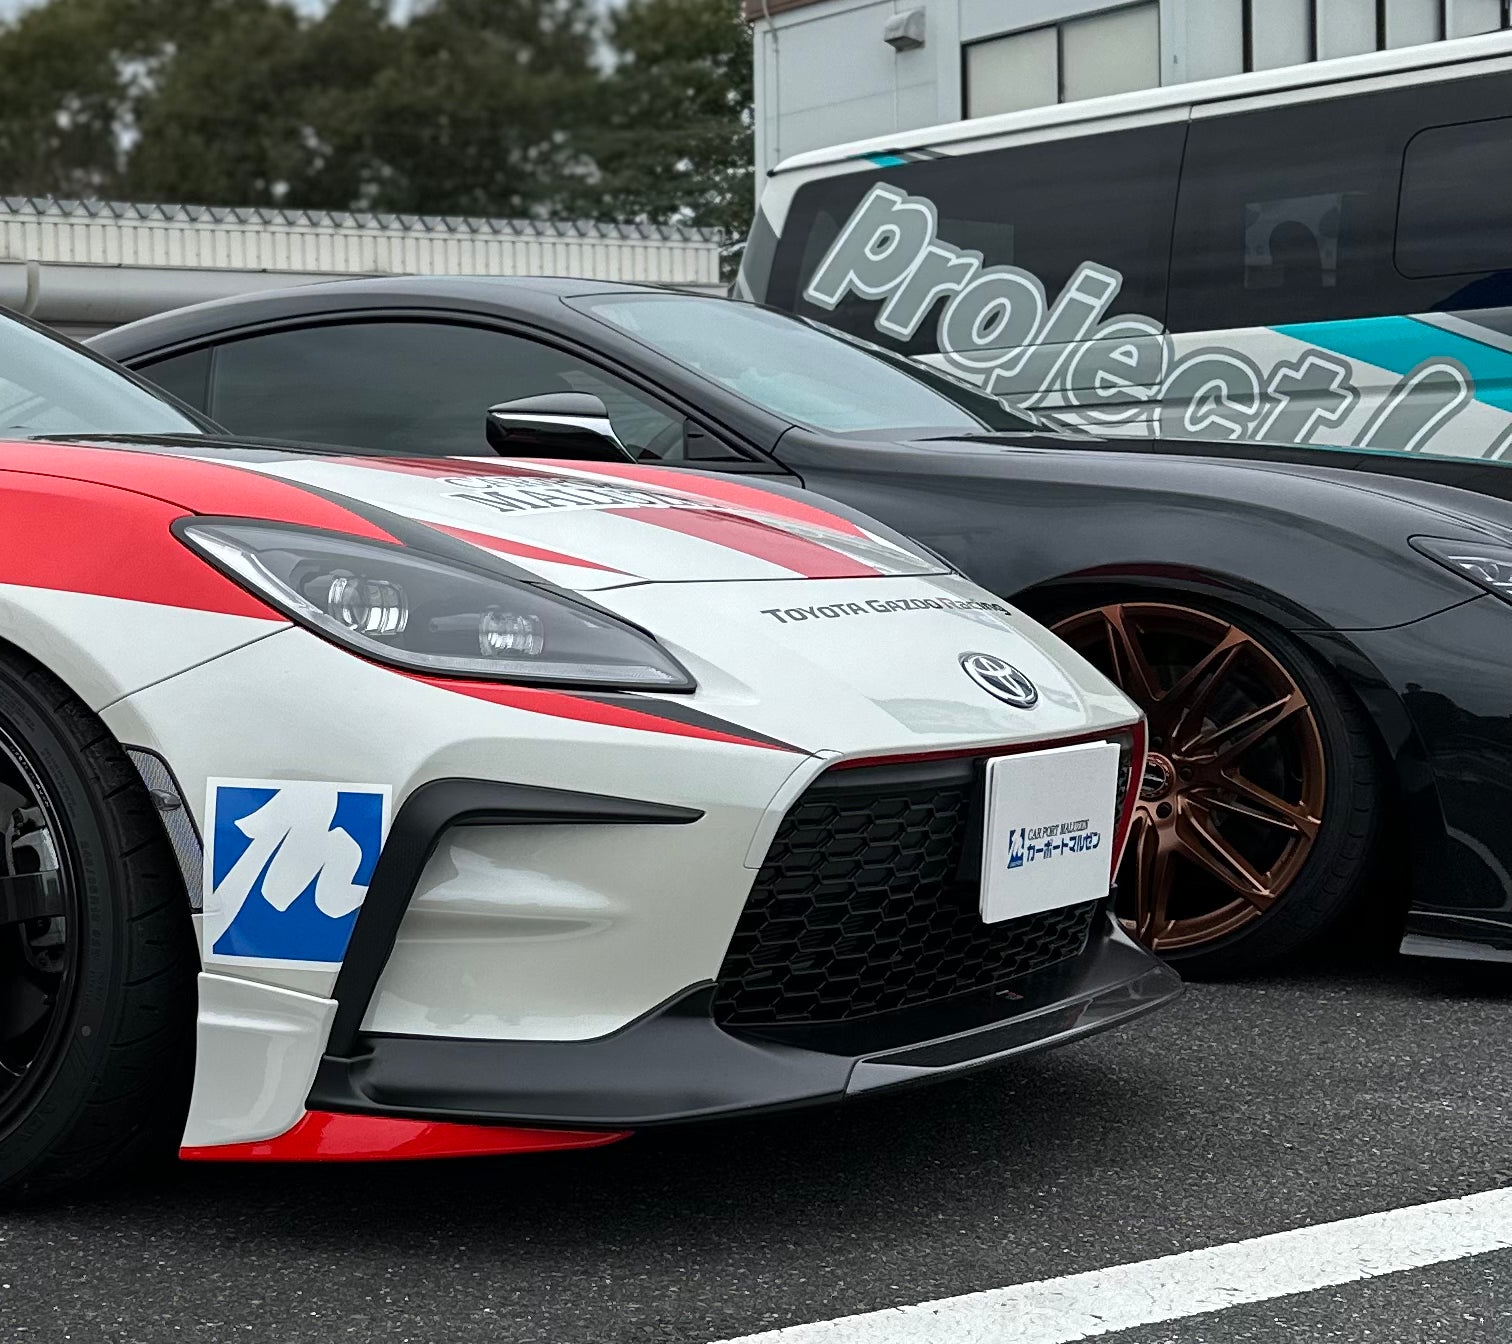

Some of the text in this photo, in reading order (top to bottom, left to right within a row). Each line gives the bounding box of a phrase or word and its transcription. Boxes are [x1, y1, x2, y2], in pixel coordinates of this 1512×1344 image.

[760, 602, 870, 623] TOYOTA
[937, 597, 1013, 616] Racing
[1026, 831, 1101, 862] カーポートマルゼン
